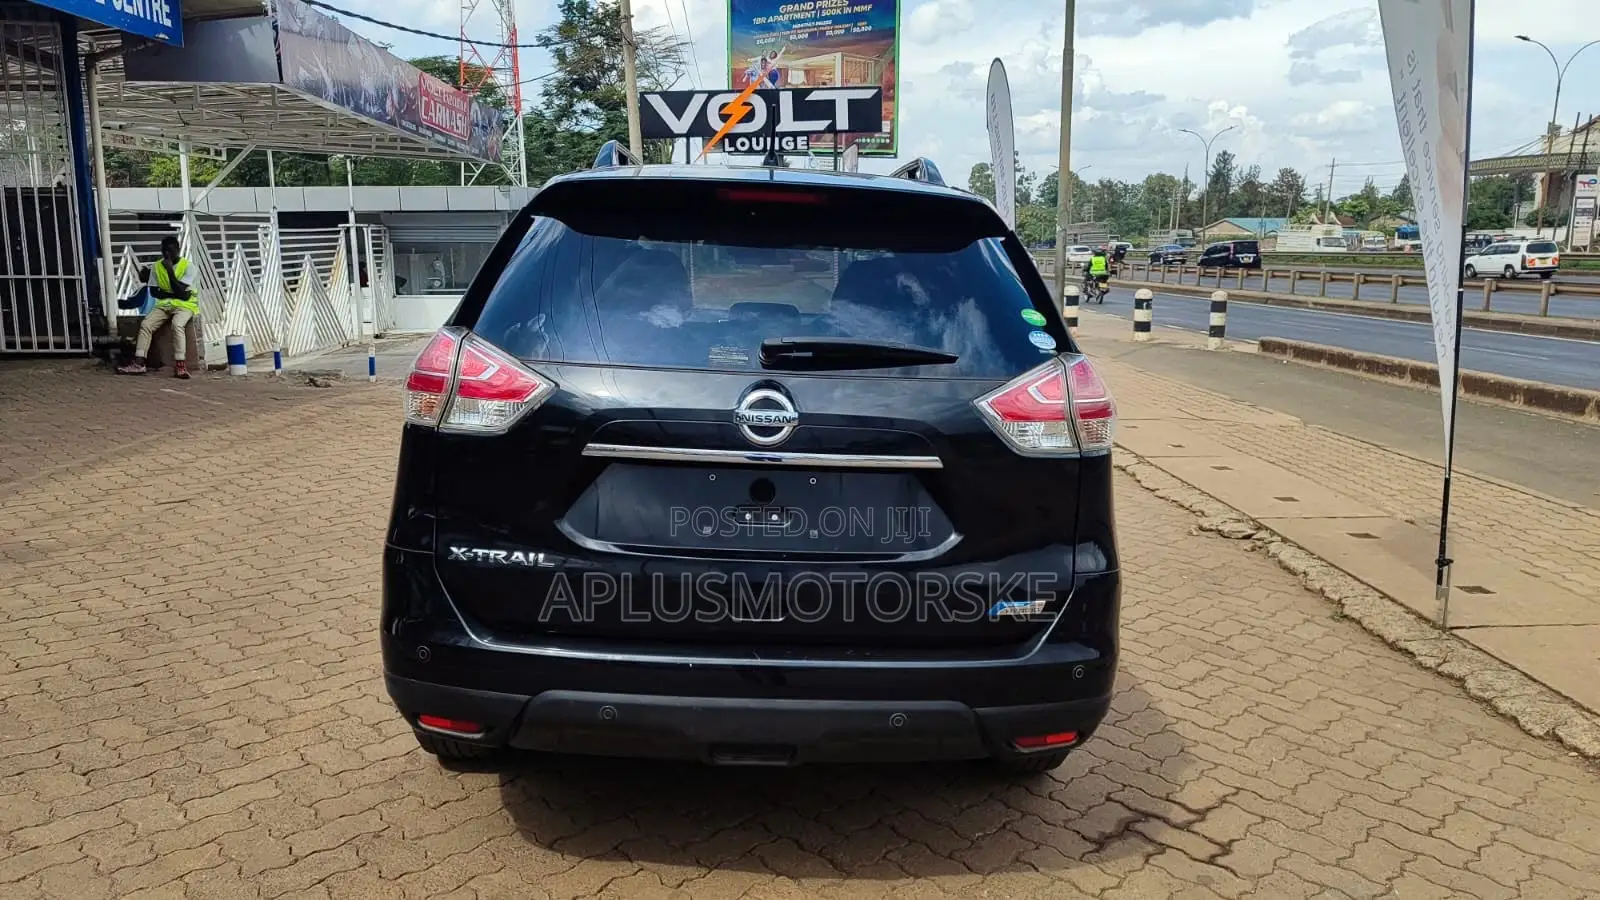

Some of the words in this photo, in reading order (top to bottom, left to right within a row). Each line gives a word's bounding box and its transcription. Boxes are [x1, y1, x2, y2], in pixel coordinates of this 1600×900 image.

[767, 11, 817, 23] APARTMENT
[843, 6, 852, 14] IN
[853, 4, 873, 13] MMF
[779, 2, 813, 14] GRAND
[815, 0, 849, 9] PRIZES
[421, 95, 468, 138] CARWASH
[643, 88, 879, 135] VOLT
[724, 136, 808, 151] LOUNGE
[741, 414, 791, 423] NISSAN
[448, 546, 555, 568] X-TRAIL
